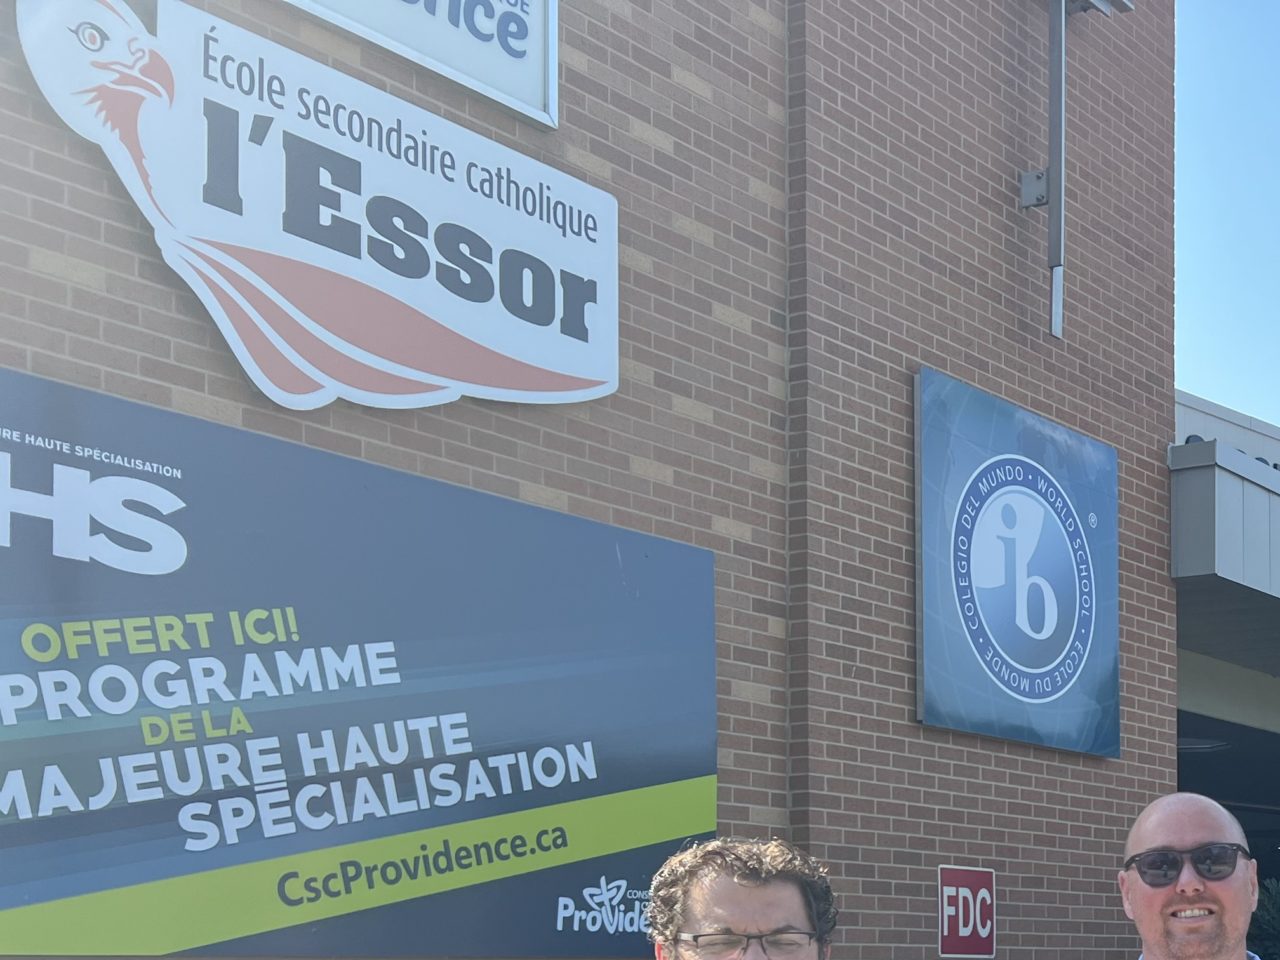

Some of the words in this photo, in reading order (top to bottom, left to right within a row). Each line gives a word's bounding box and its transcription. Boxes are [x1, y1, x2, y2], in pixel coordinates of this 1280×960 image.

[202, 26, 286, 110] École
[297, 87, 456, 183] secondaire
[466, 161, 598, 243] catholique
[202, 97, 598, 343] l'Essor
[25, 433, 71, 453] HAUTE
[75, 445, 182, 479] SPÉCIALISATION
[978, 465, 1024, 496] MUNDO
[0, 451, 188, 575] HS
[961, 495, 981, 529] DEL
[1037, 475, 1075, 532] WORLD
[1072, 538, 1091, 617] SCHOOL
[957, 536, 979, 630] COLEGIO
[21, 613, 214, 662] OFFERT
[229, 607, 300, 645] ICI!
[0, 641, 401, 726] PROGRAMME
[984, 646, 1030, 692] MONDE
[1035, 677, 1052, 693] DU
[140, 712, 196, 745] DE
[202, 706, 254, 738] LA
[297, 712, 473, 777] HAUTE
[277, 825, 569, 907] CscProvidence.ca
[943, 886, 992, 938] FDC
